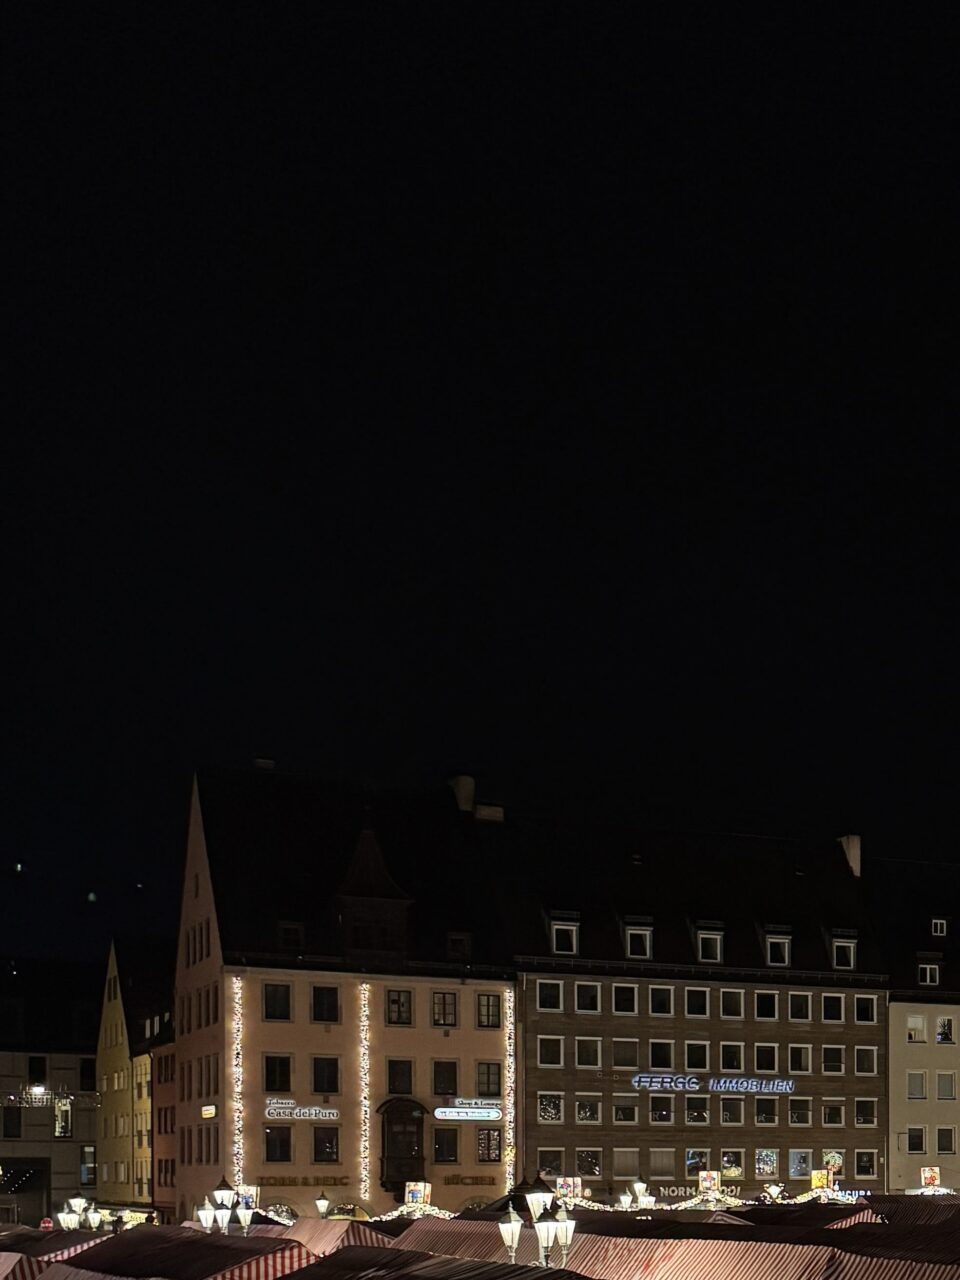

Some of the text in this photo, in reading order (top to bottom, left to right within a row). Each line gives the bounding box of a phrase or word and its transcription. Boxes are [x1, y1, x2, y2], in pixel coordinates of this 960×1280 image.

[709, 1078, 794, 1092] IMMOBILIEN
[267, 1108, 339, 1119] Casa del Puro
